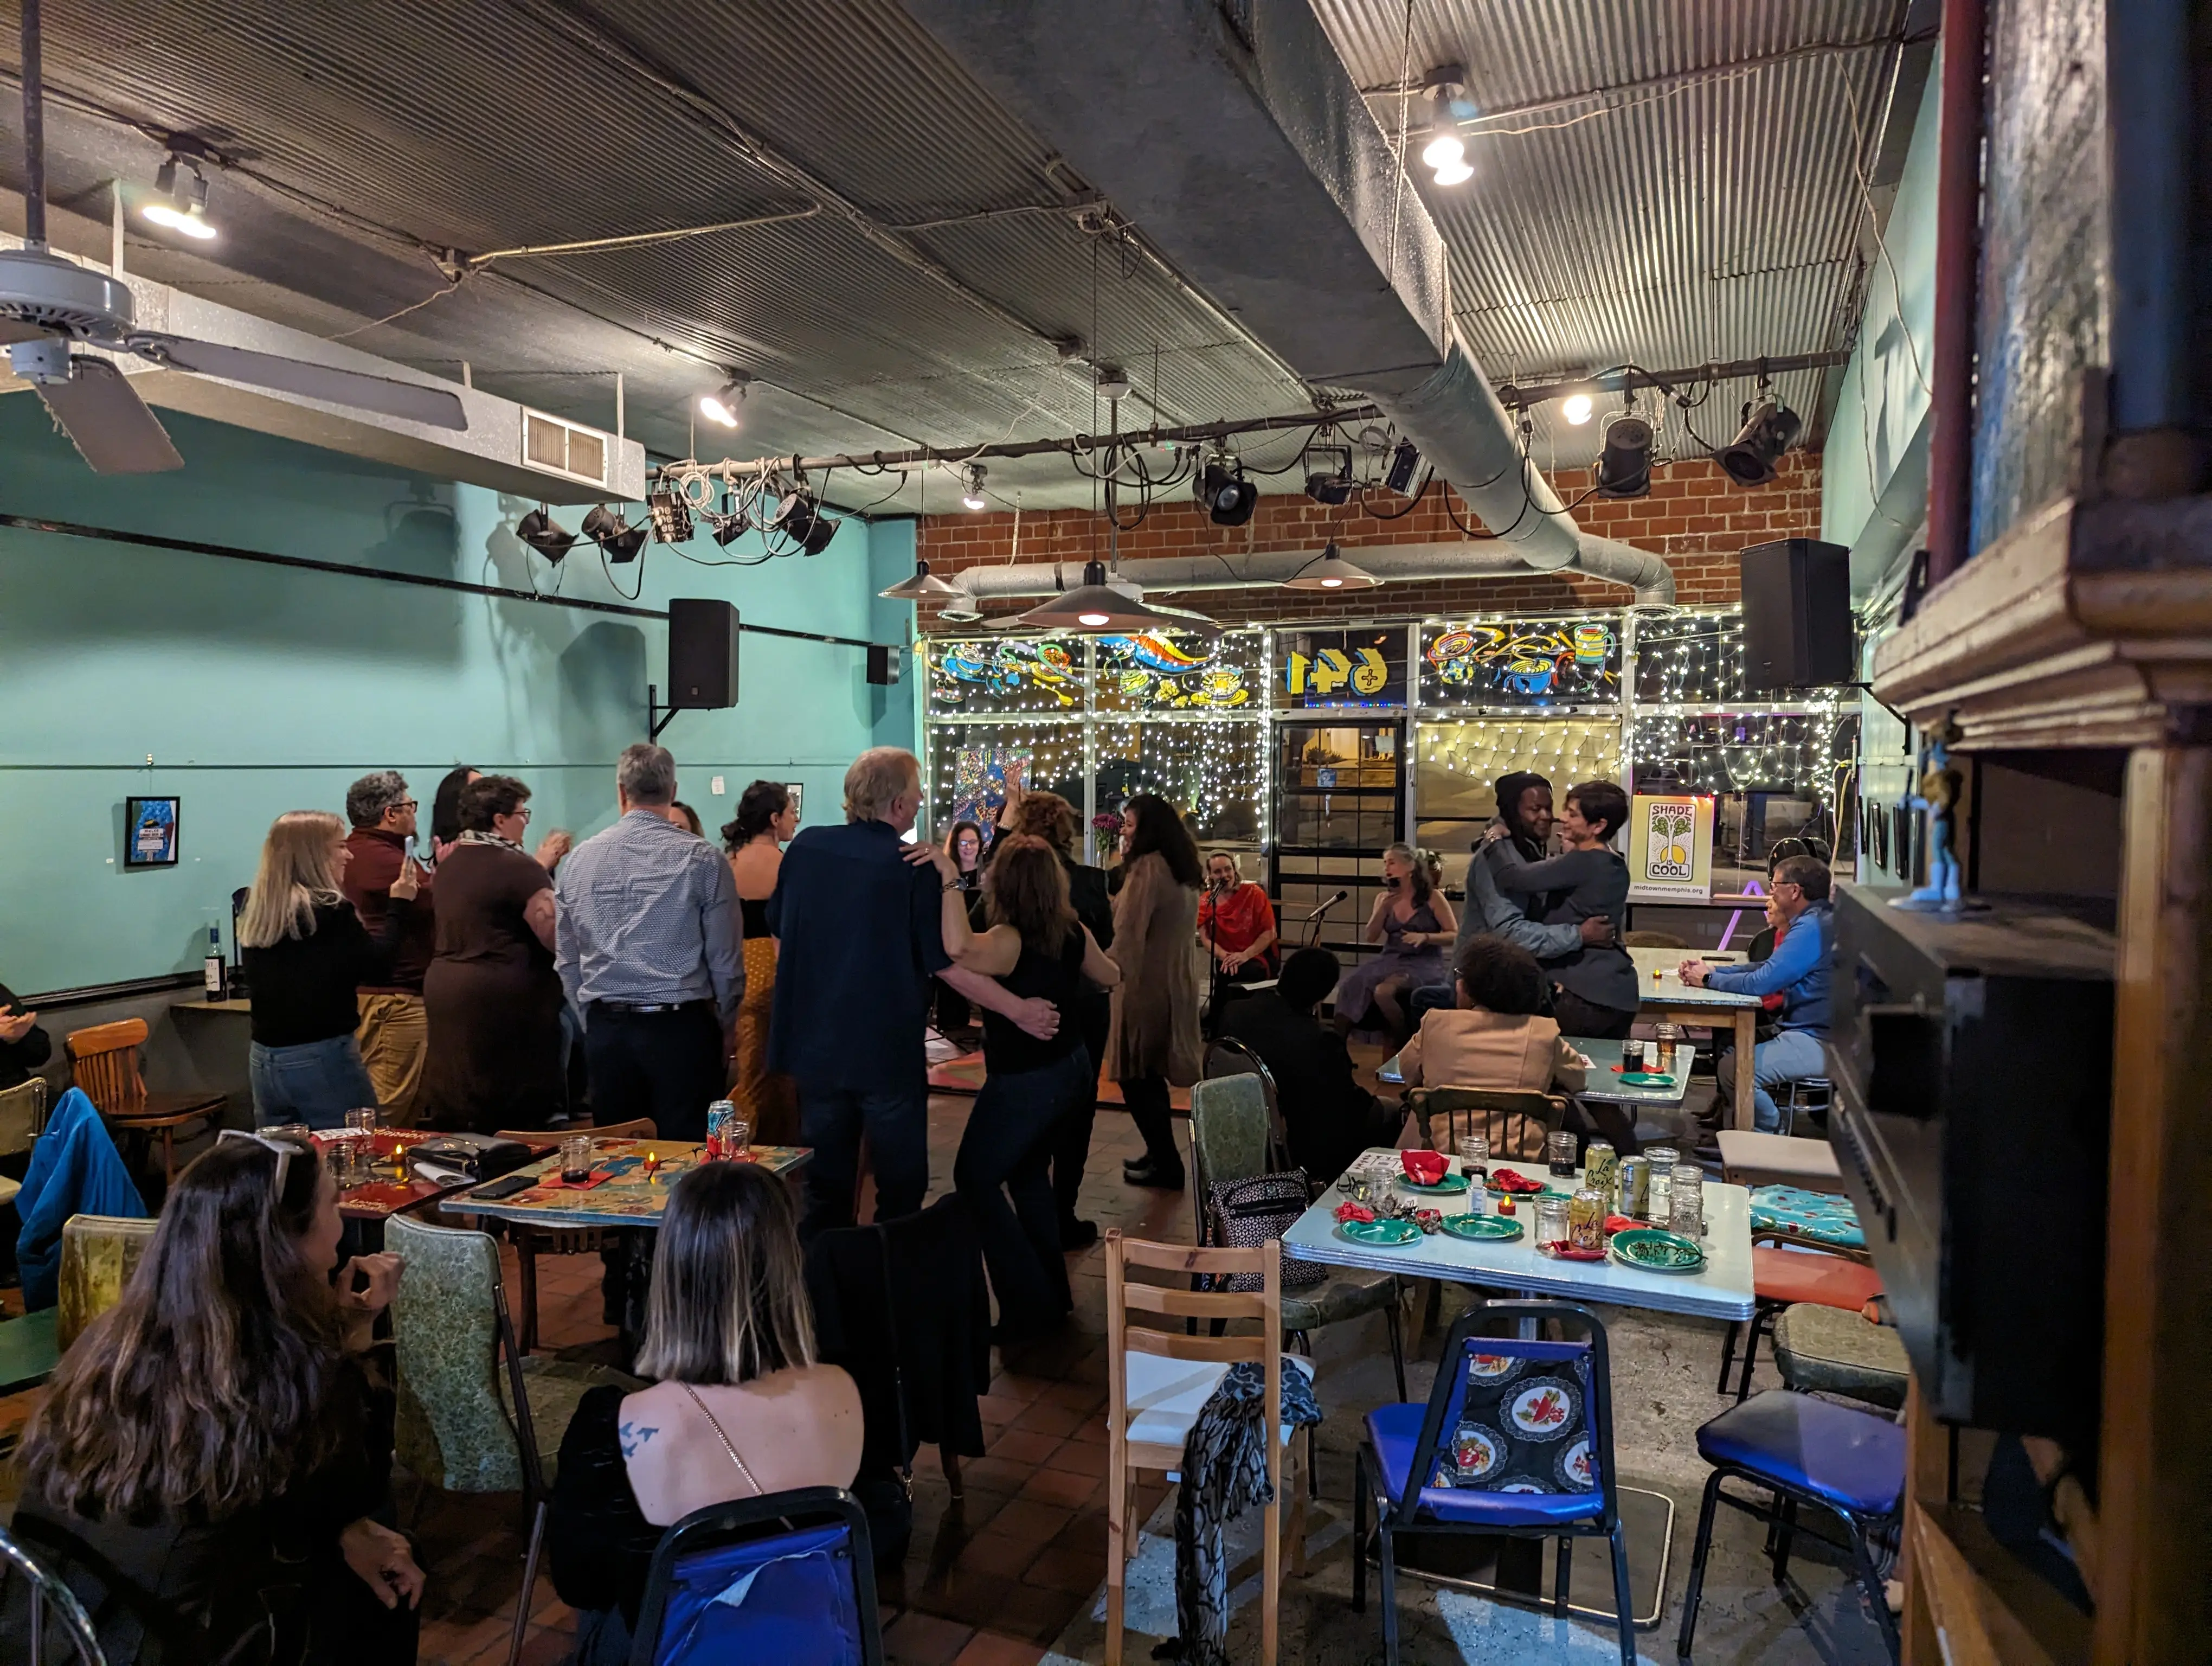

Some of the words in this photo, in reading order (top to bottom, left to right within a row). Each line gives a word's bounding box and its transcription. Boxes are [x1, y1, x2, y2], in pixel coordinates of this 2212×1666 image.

[1652, 805, 1693, 816] SHADE
[1651, 864, 1687, 876] COOL
[1634, 885, 1703, 894] midtownmemphis.org
